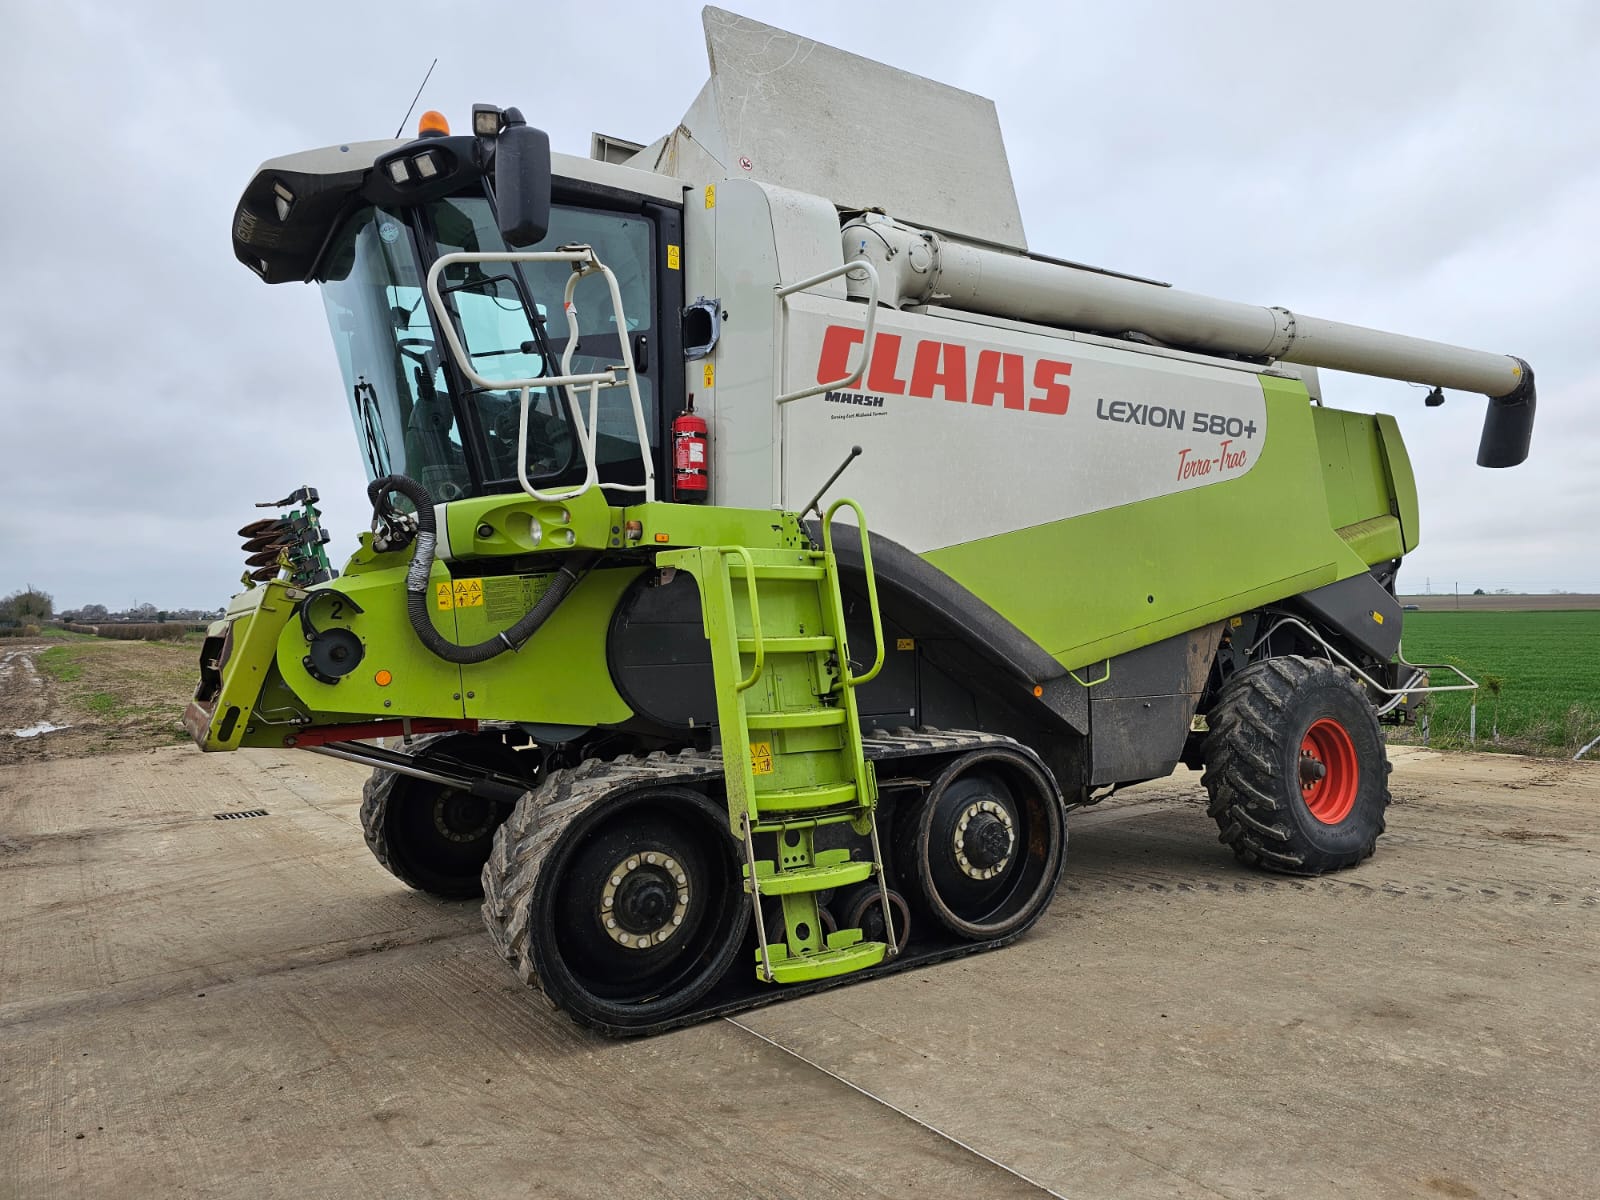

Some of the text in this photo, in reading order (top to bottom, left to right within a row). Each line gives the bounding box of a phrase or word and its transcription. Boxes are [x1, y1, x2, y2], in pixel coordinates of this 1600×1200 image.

[816, 324, 1073, 416] CLAAS
[824, 391, 885, 408] MARSH
[1096, 398, 1257, 439] LEXION 580+
[1177, 439, 1247, 482] Terra-Trac
[331, 600, 344, 620] 2
